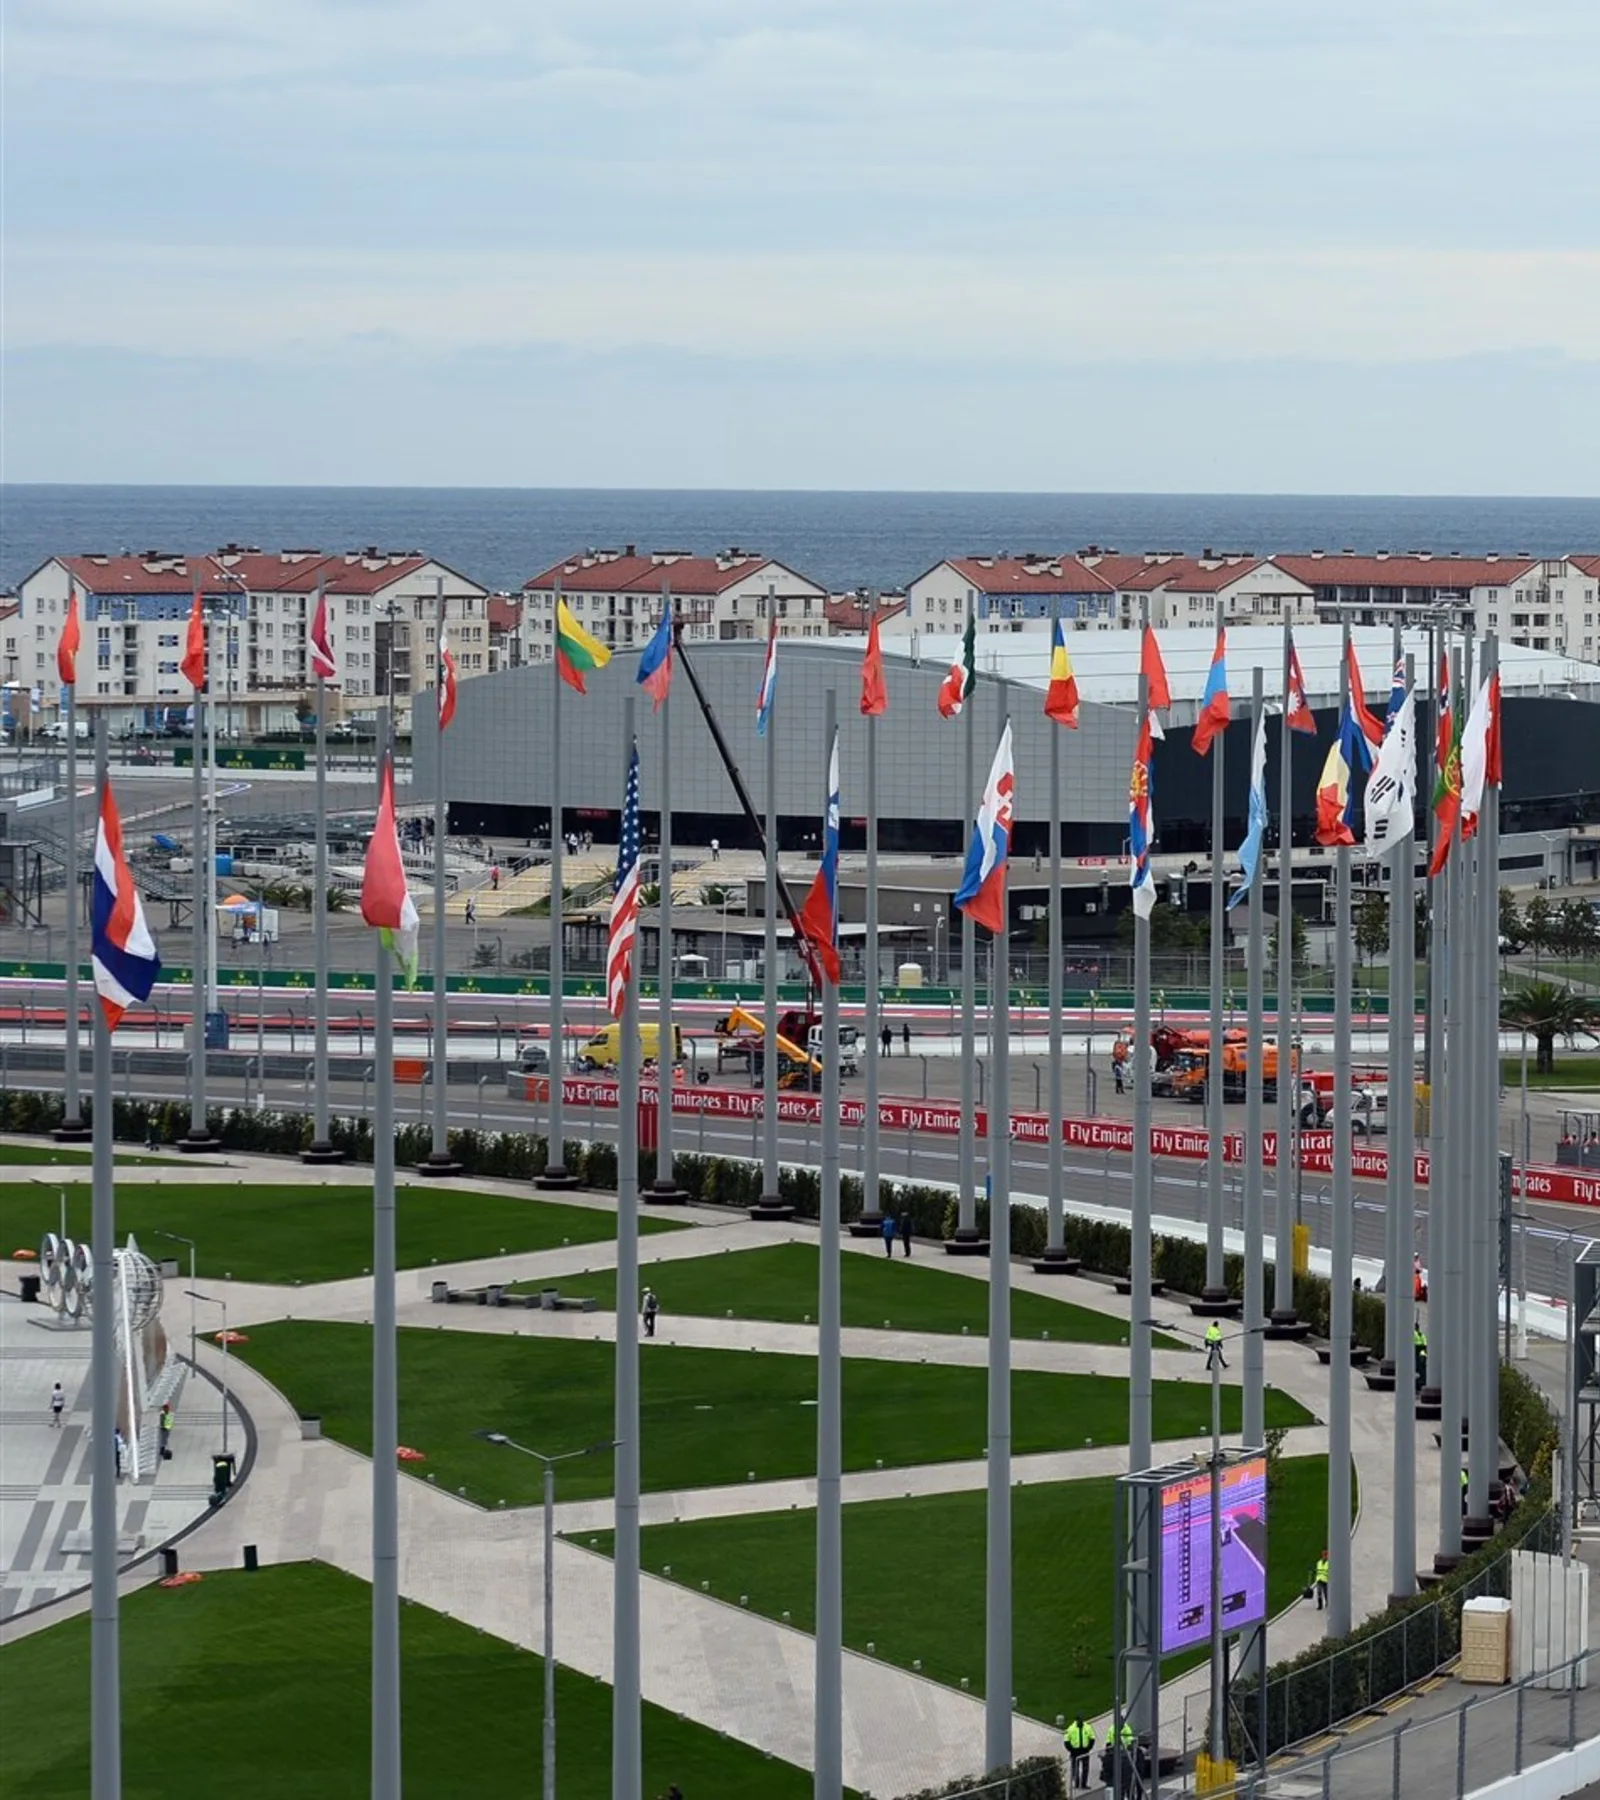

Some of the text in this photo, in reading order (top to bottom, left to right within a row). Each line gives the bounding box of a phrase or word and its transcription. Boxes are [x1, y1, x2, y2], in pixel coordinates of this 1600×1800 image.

[728, 1096, 747, 1114] Fly
[901, 1109, 922, 1127] Fly
[1070, 1124, 1089, 1144] Fly
[1153, 1131, 1173, 1152] Fly
[1573, 1179, 1593, 1201] Fly
